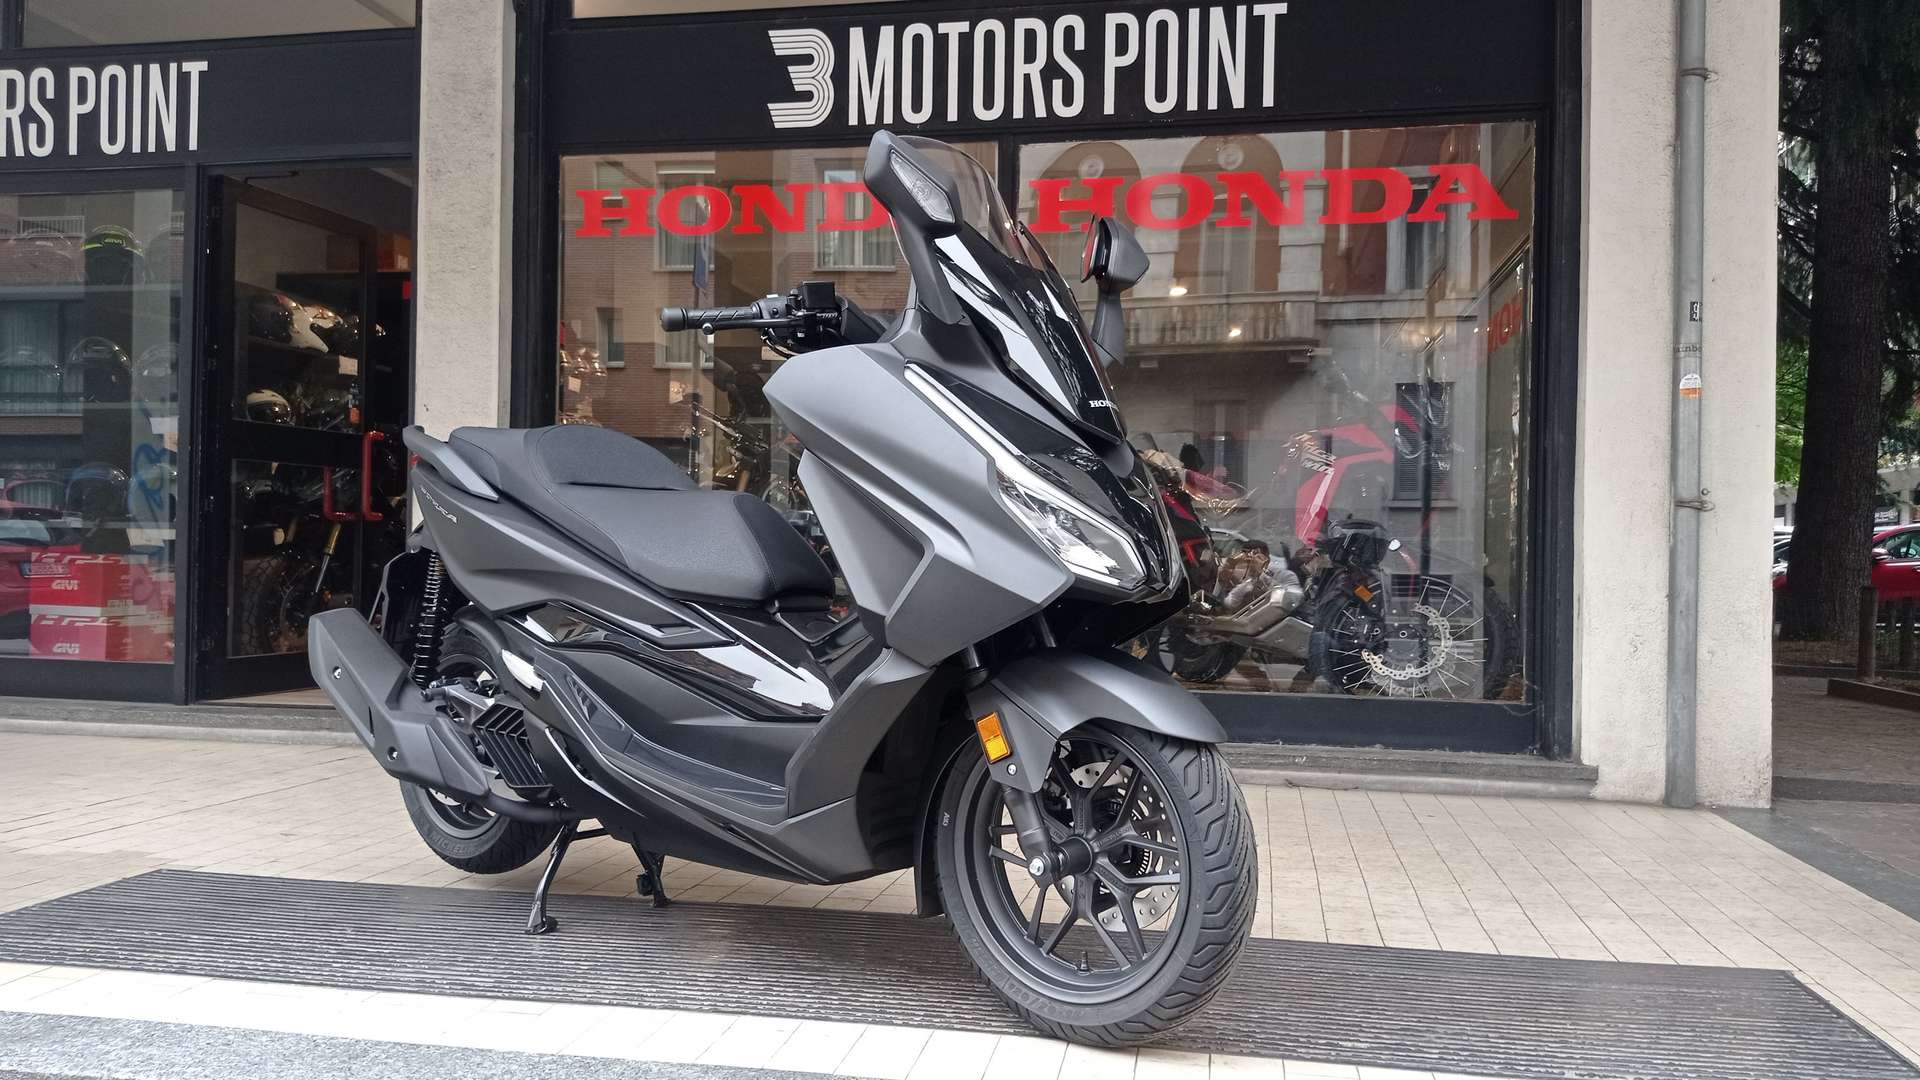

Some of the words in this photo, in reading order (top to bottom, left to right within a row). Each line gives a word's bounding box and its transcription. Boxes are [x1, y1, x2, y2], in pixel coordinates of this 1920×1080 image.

[849, 12, 1085, 126] MOTORS
[1103, 2, 1289, 115] POINT
[68, 60, 209, 156] POINT
[576, 182, 890, 238] HOND
[1029, 163, 1519, 234] HONDA
[52, 579, 79, 590] GIVI
[53, 643, 80, 654] GIVI
